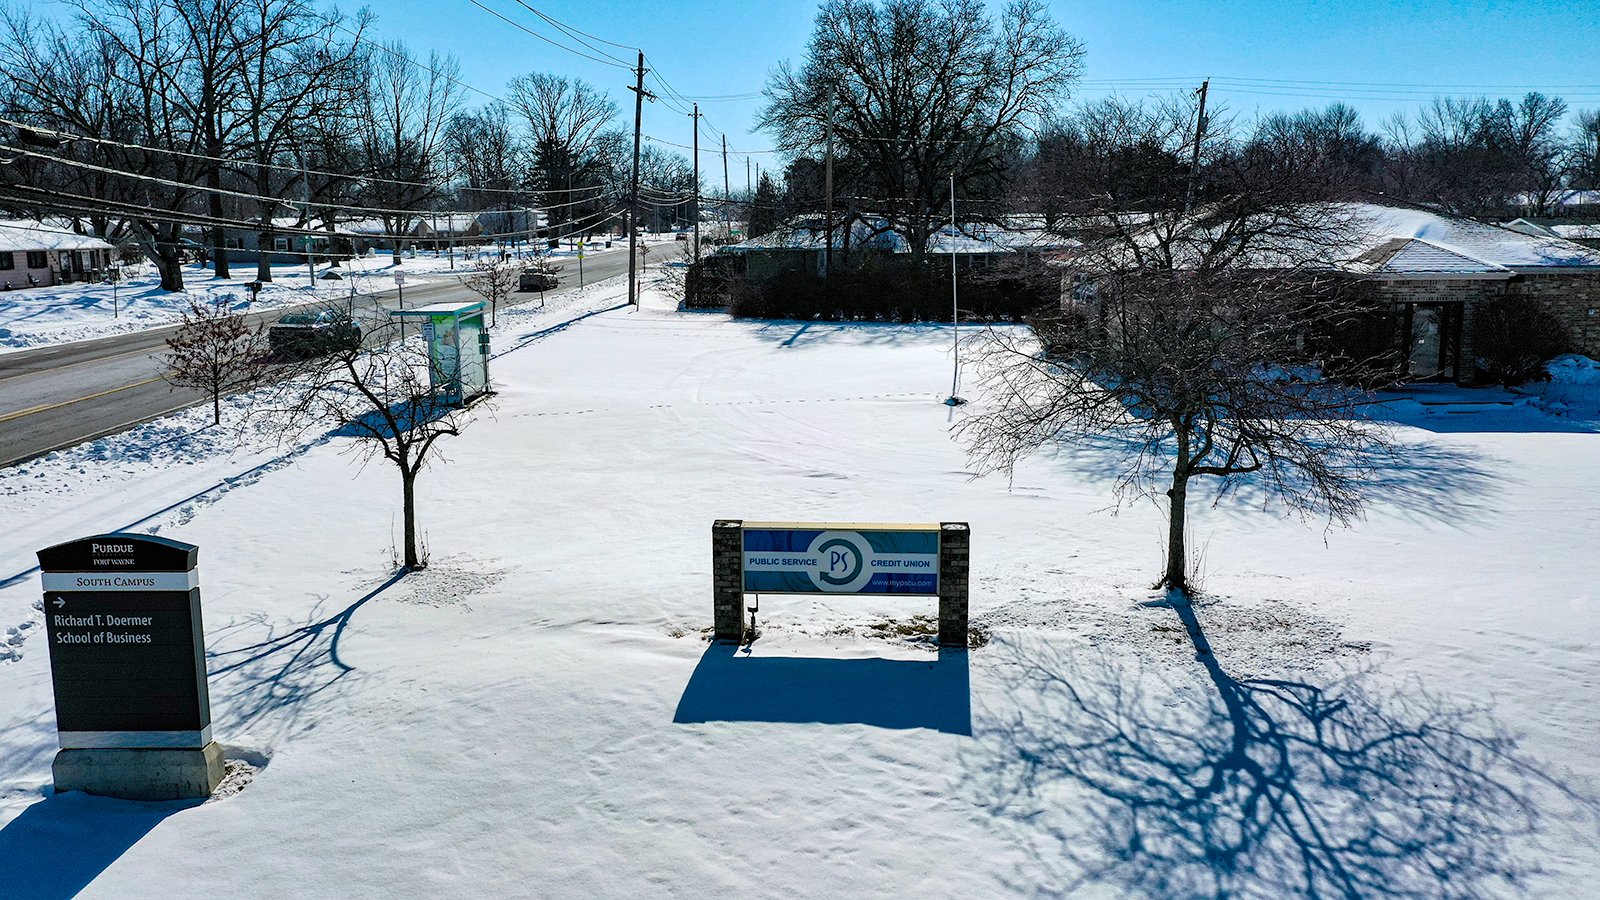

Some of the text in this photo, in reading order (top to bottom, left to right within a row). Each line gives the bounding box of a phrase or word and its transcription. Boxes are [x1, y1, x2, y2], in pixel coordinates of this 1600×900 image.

[92, 543, 134, 554] PURDUE
[93, 558, 135, 566] FORT WAYNE
[749, 557, 818, 567] PUBLIC SERVICE
[830, 551, 849, 572] PS
[870, 559, 931, 569] CREDIT UNION
[76, 577, 155, 587] SOUTH CAMPUS
[871, 578, 933, 588] www.mypscu.com
[54, 615, 153, 626] Richard T. Doermer
[57, 632, 152, 644] School of Business
